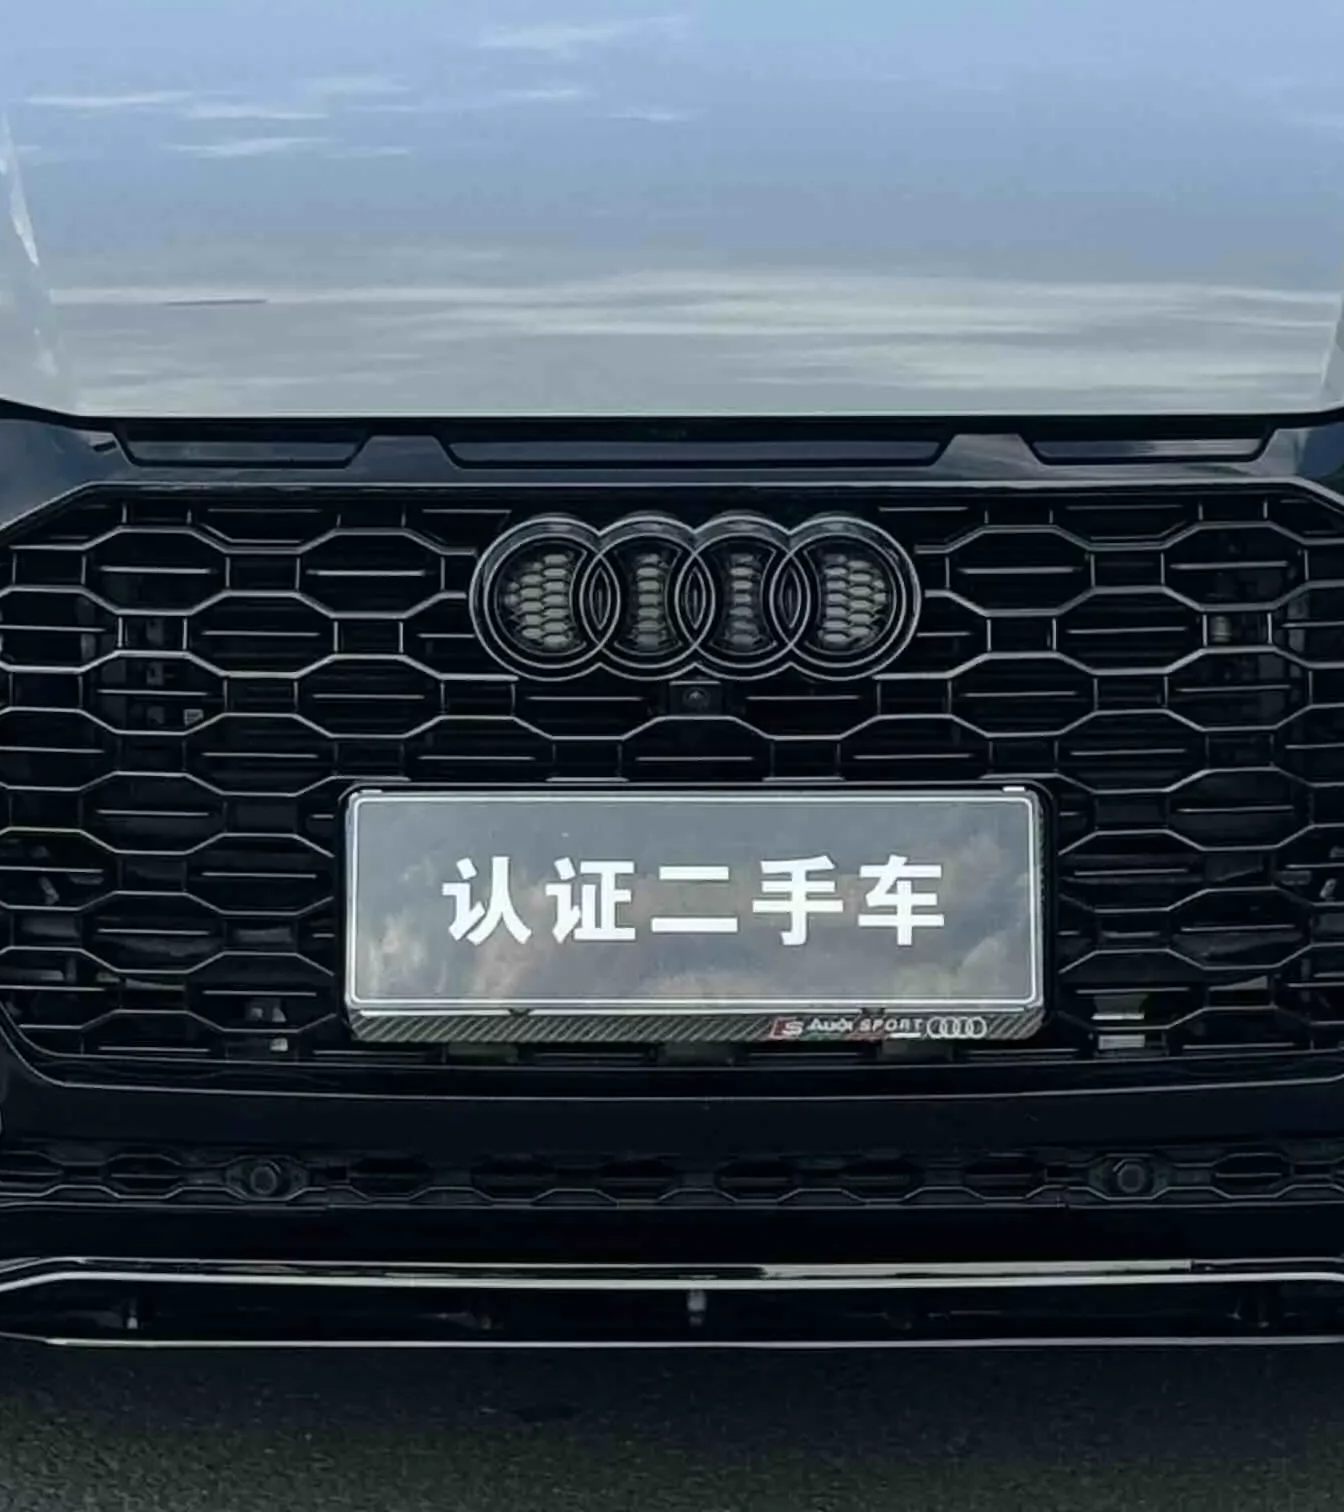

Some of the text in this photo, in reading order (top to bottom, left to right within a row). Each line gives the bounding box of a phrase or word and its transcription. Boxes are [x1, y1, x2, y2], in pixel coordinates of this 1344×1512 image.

[440, 854, 946, 947] 认证二手车
[807, 1017, 855, 1032] Audi
[859, 1018, 924, 1032] SPORT
